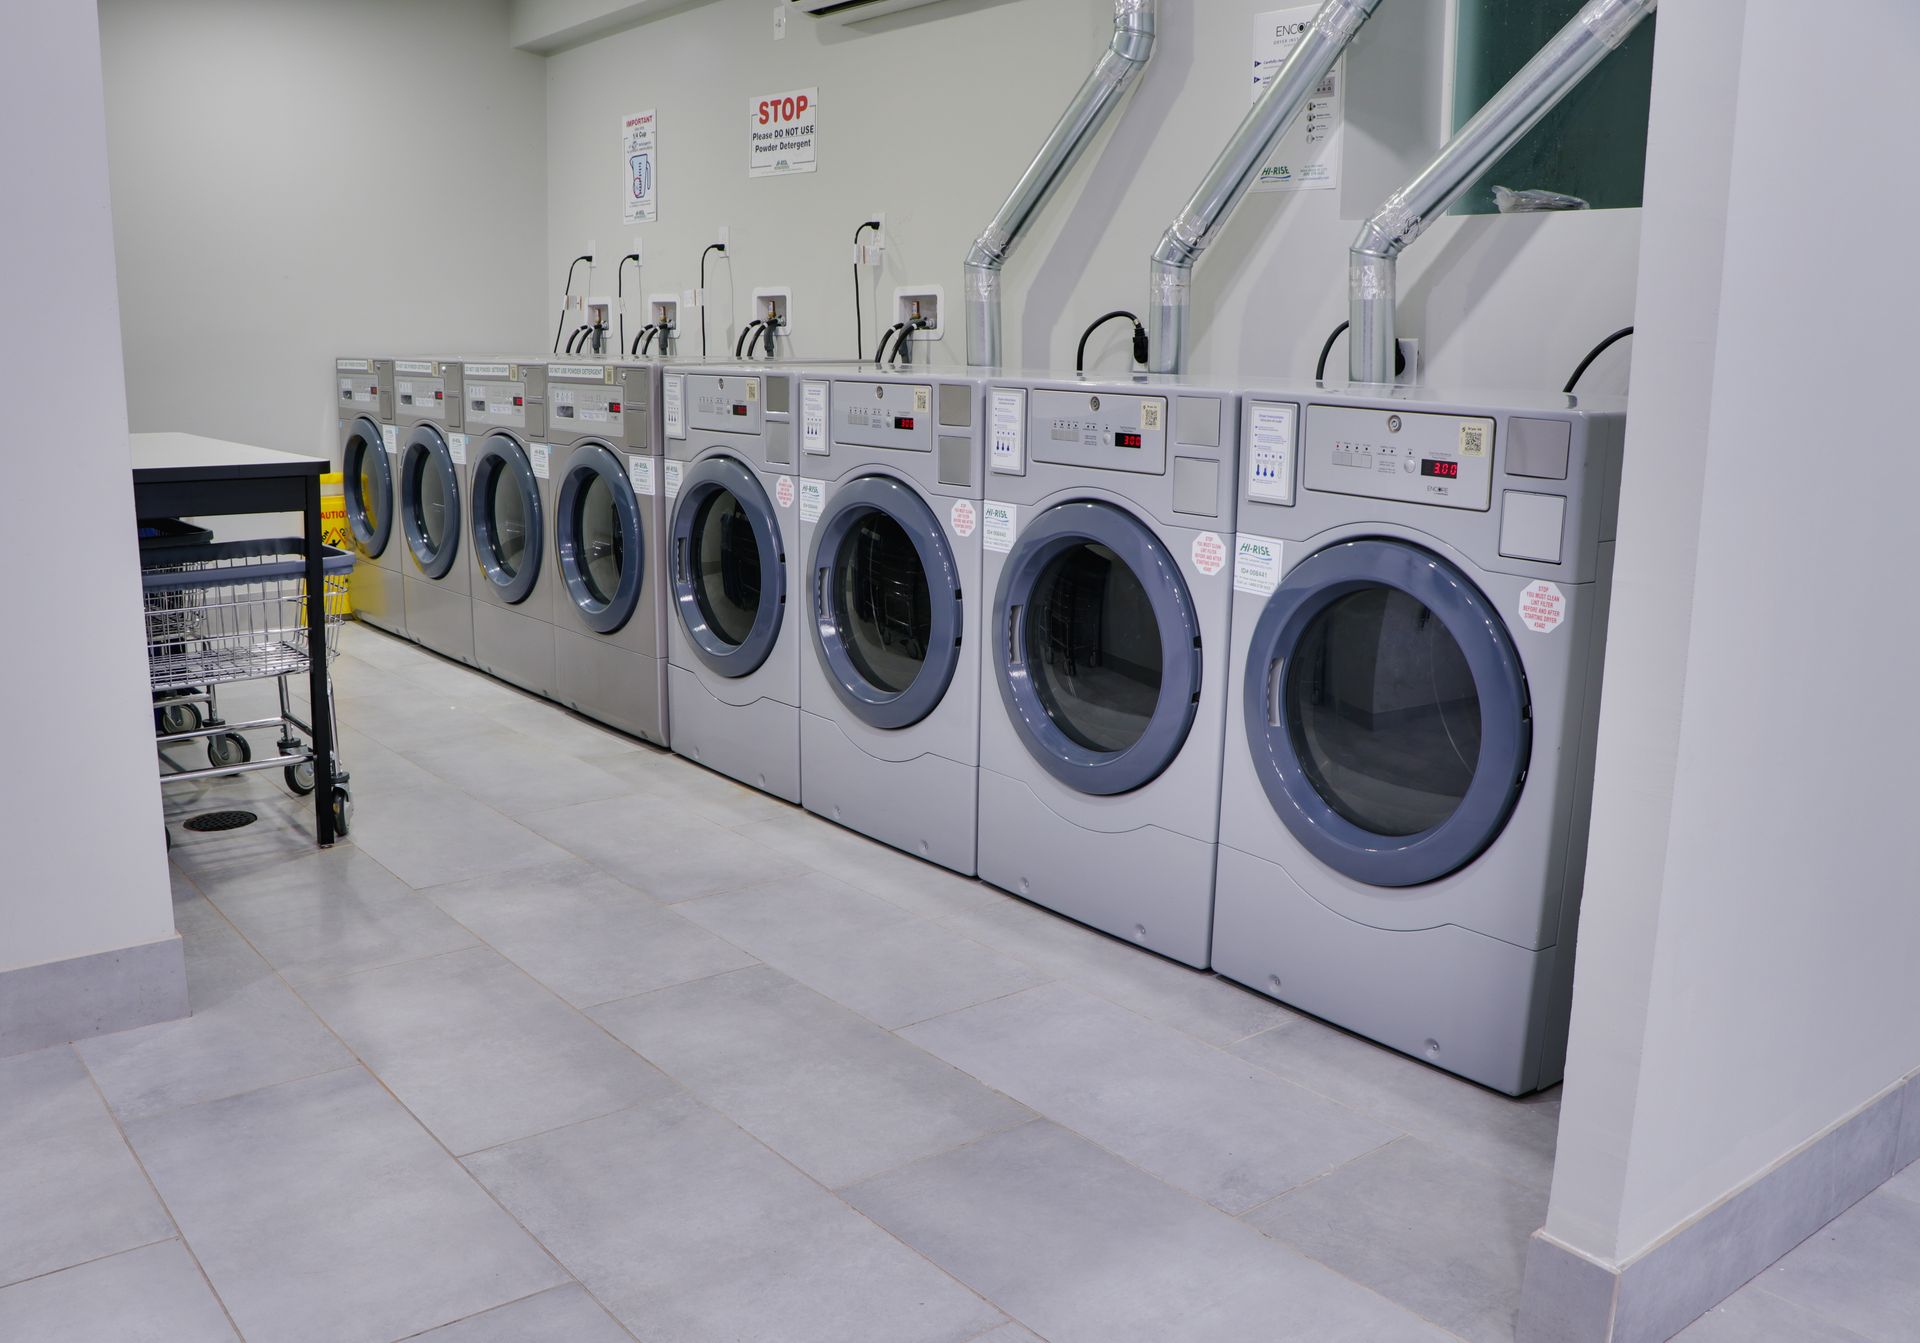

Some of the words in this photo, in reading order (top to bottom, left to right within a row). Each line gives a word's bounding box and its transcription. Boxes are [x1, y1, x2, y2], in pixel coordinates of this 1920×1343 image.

[759, 95, 808, 125] STOP
[626, 115, 653, 127] IMPORTANT
[752, 132, 773, 141] Please
[774, 129, 784, 138] DO
[785, 127, 799, 137] NOT
[800, 125, 814, 135] USE
[755, 143, 778, 153] Powder
[779, 139, 811, 151] Detergent
[1261, 166, 1290, 176] HI-RISE
[321, 511, 345, 520] AUTIO
[985, 508, 1008, 519] HI-RISE
[1240, 543, 1271, 556] HI-RISE
[1523, 605, 1538, 613] BEFORE
[1547, 609, 1560, 617] AFTER
[1524, 613, 1543, 621] STARTING
[1543, 616, 1557, 624] DRYER
